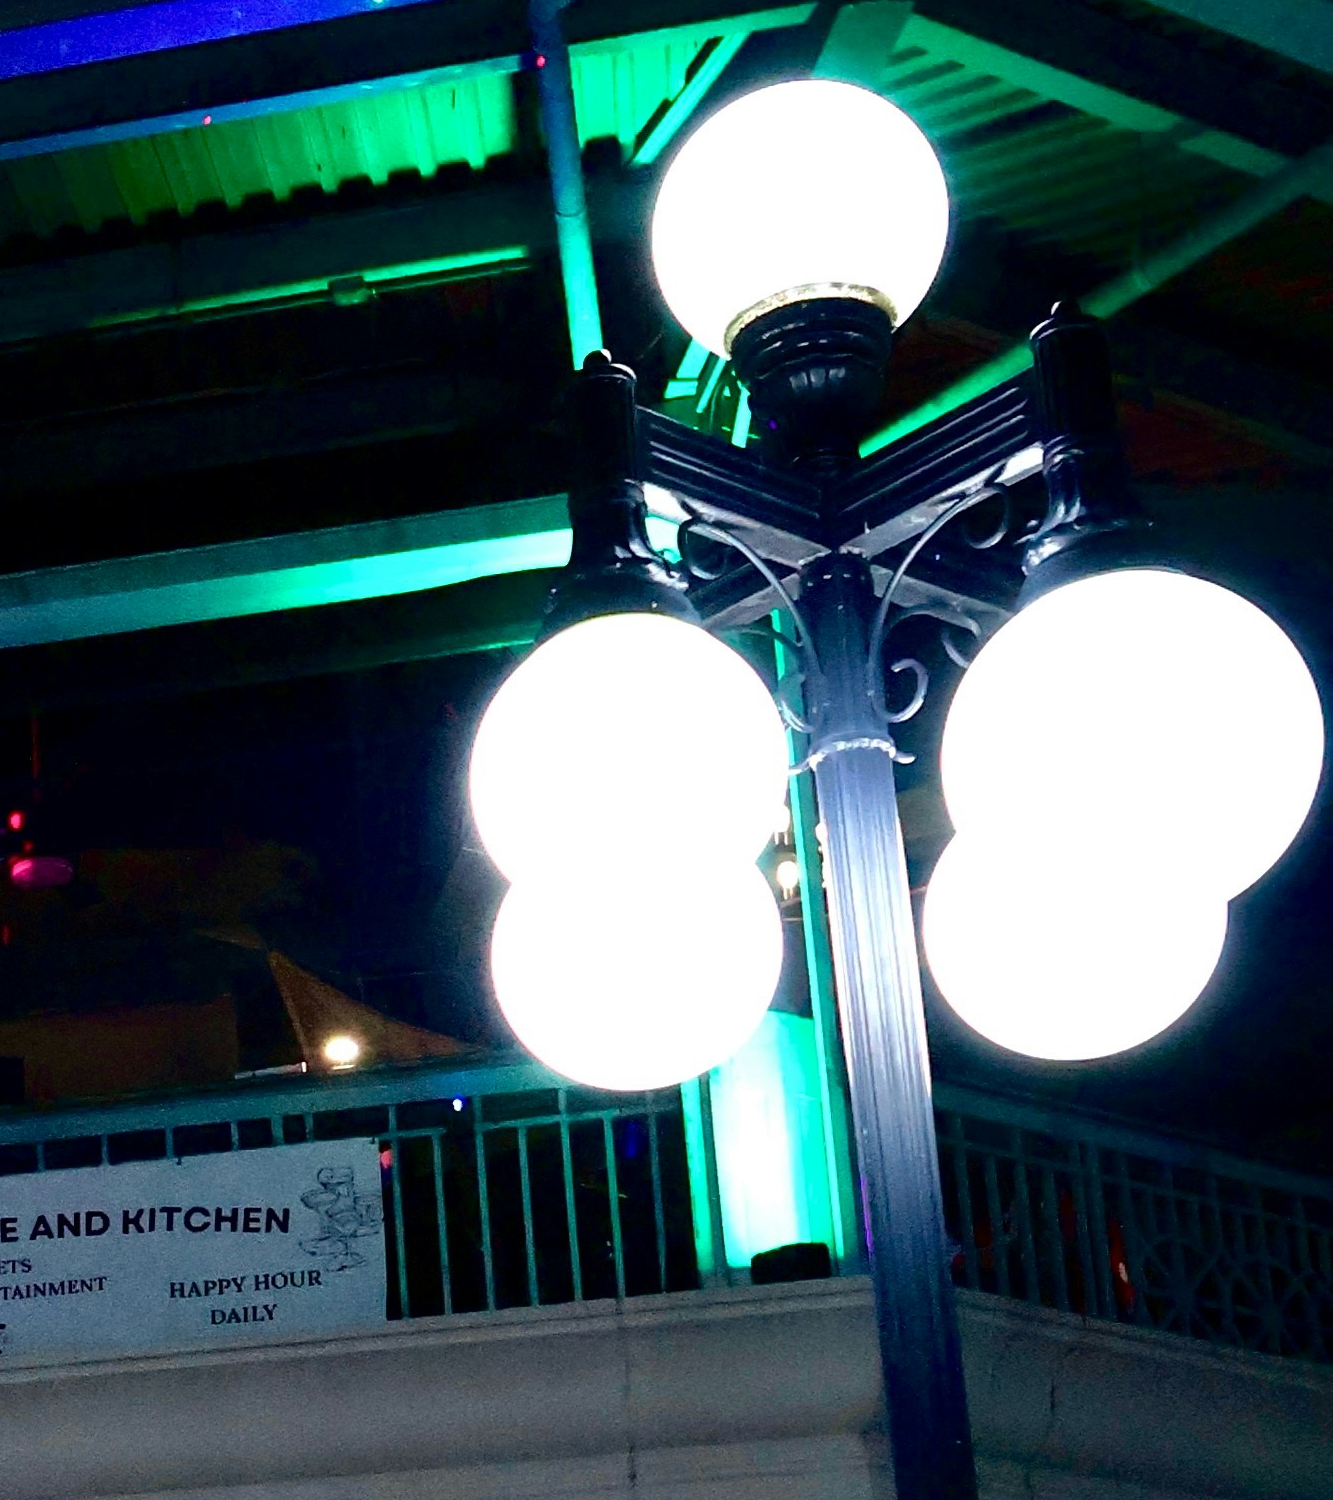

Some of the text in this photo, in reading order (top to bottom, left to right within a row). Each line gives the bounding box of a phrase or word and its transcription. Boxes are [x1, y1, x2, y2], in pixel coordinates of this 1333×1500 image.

[28, 1209, 111, 1240] AND
[121, 1206, 291, 1236] KITCHEN
[169, 1270, 323, 1299] HAPPY HOUR
[210, 1303, 278, 1326] DAILY
